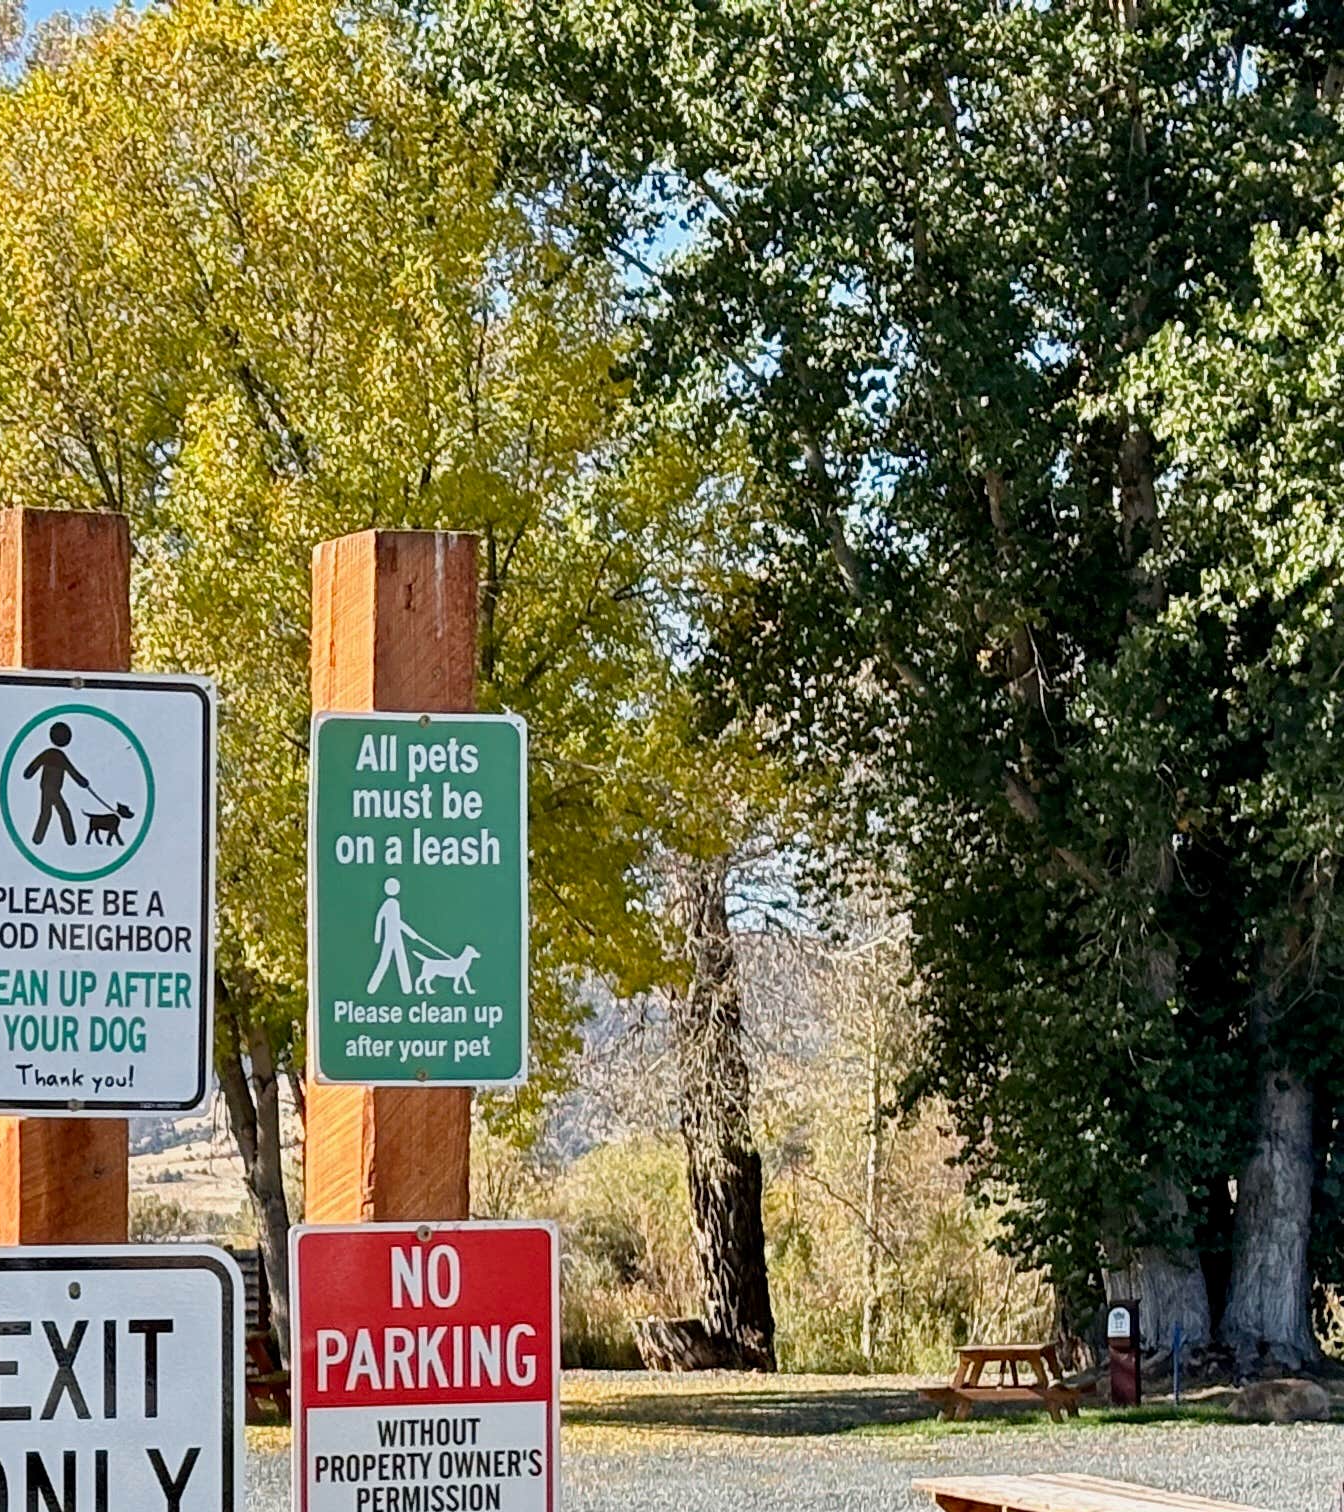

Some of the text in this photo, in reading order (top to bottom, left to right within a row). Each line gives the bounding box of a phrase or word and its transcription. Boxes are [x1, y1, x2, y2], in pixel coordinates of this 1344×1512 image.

[355, 735, 479, 782] All pets
[353, 782, 482, 819] must be
[335, 828, 500, 865] on a leash
[103, 890, 139, 916] BE
[146, 891, 164, 917] A
[48, 923, 191, 952] NEIGHBOR
[59, 970, 97, 1007] UP
[105, 972, 191, 1008] AFTER
[334, 1001, 502, 1027] Please clean up
[4, 1014, 146, 1053] YOUR DOG
[345, 1036, 490, 1062] after your pet
[15, 1064, 134, 1093] Thank you!
[391, 1245, 460, 1308] NO
[316, 1324, 537, 1392] PARKING
[377, 1418, 480, 1447] WITHOUT
[315, 1450, 542, 1483] PROPERTY OWNER'S
